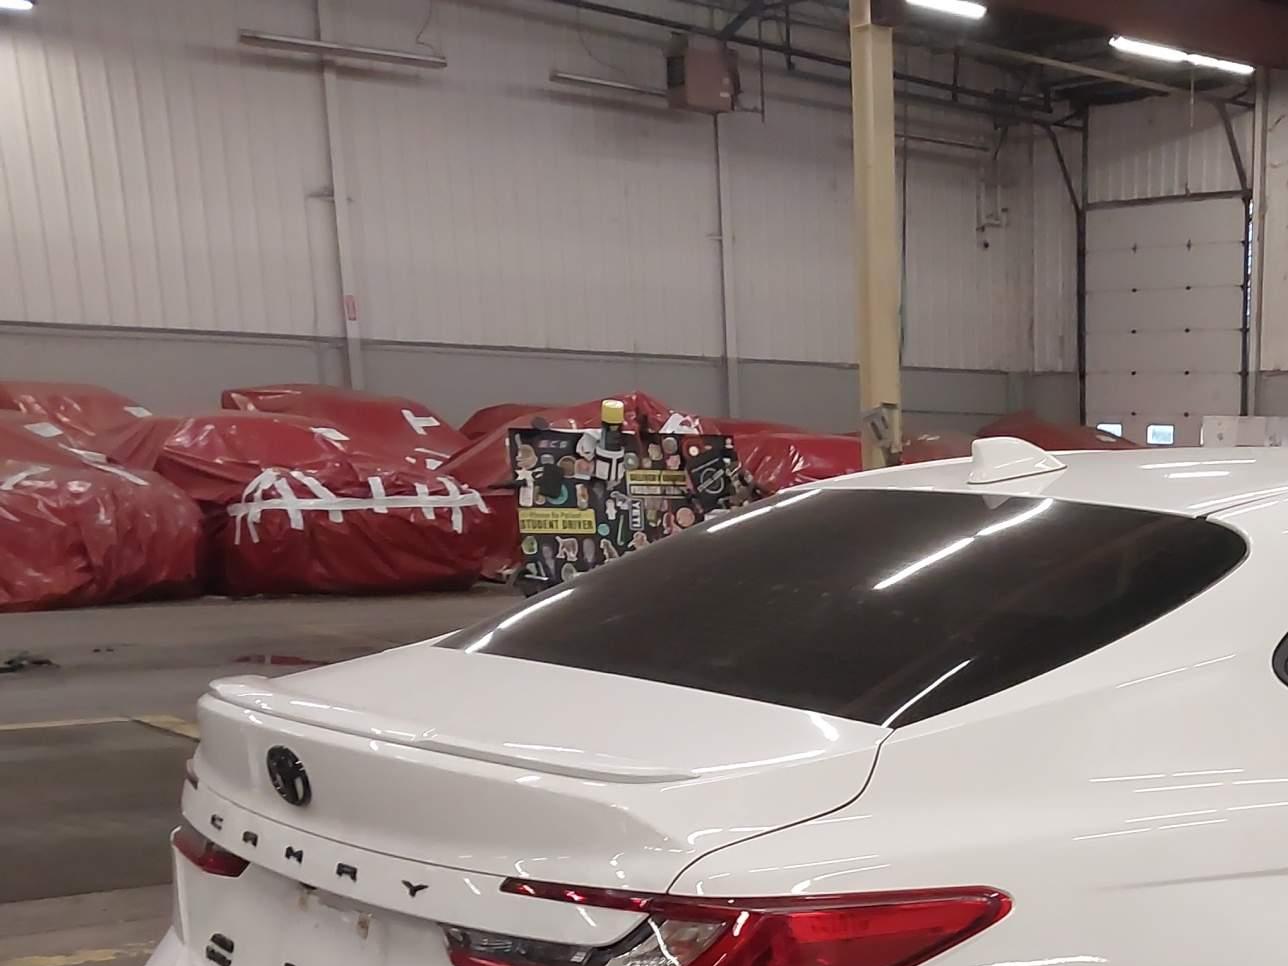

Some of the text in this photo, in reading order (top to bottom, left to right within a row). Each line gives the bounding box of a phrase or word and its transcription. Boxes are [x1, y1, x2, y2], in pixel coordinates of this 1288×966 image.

[520, 519, 594, 529] STUDENT DRIVER
[631, 500, 641, 528] YETI
[210, 814, 429, 898] CAMRY
